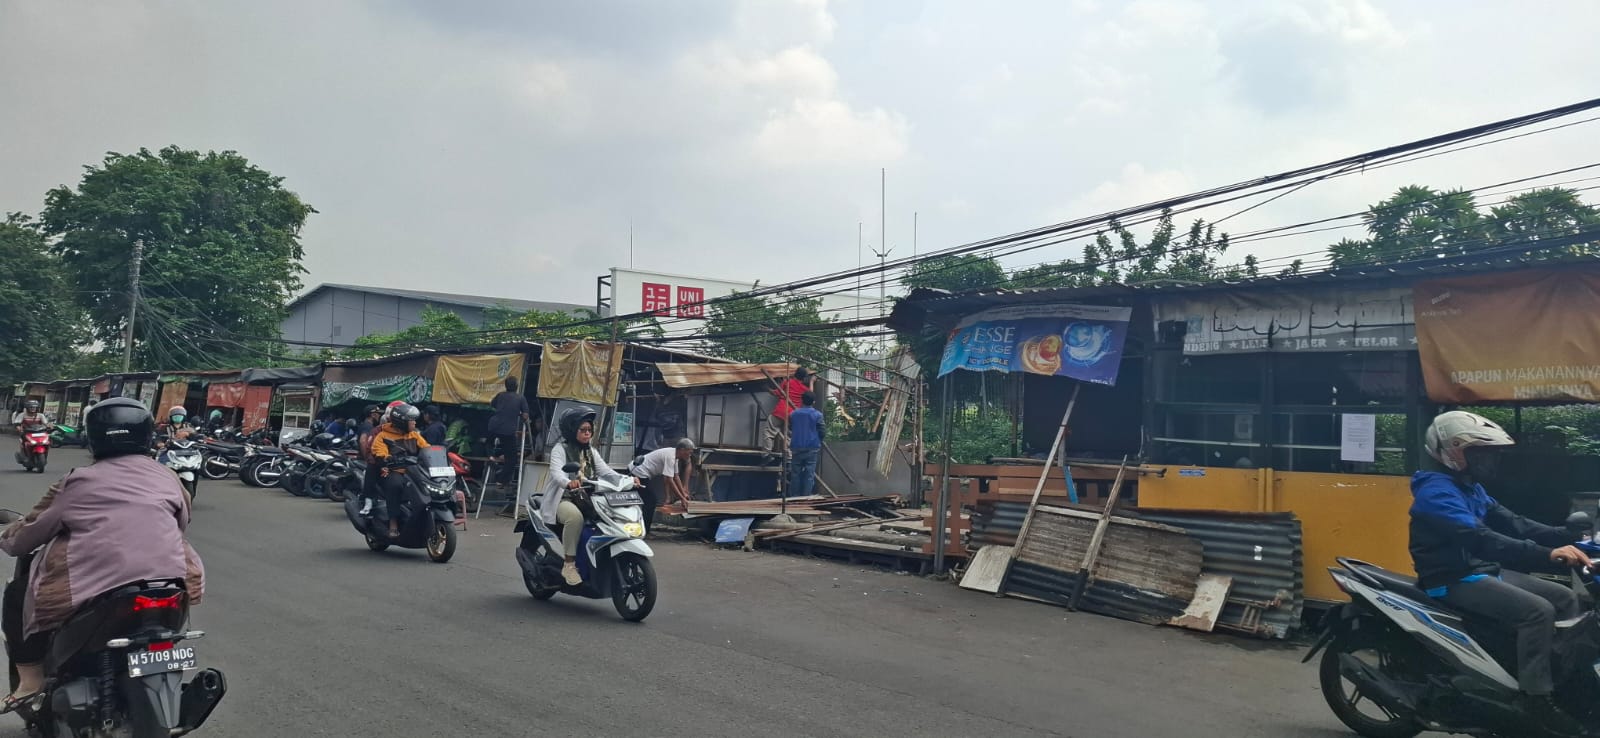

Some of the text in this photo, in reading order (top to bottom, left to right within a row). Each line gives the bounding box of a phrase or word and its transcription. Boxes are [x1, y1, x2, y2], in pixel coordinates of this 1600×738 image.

[680, 290, 699, 303] UNI
[974, 326, 1016, 343] ESSE
[130, 647, 194, 665] W 5709 NDG
